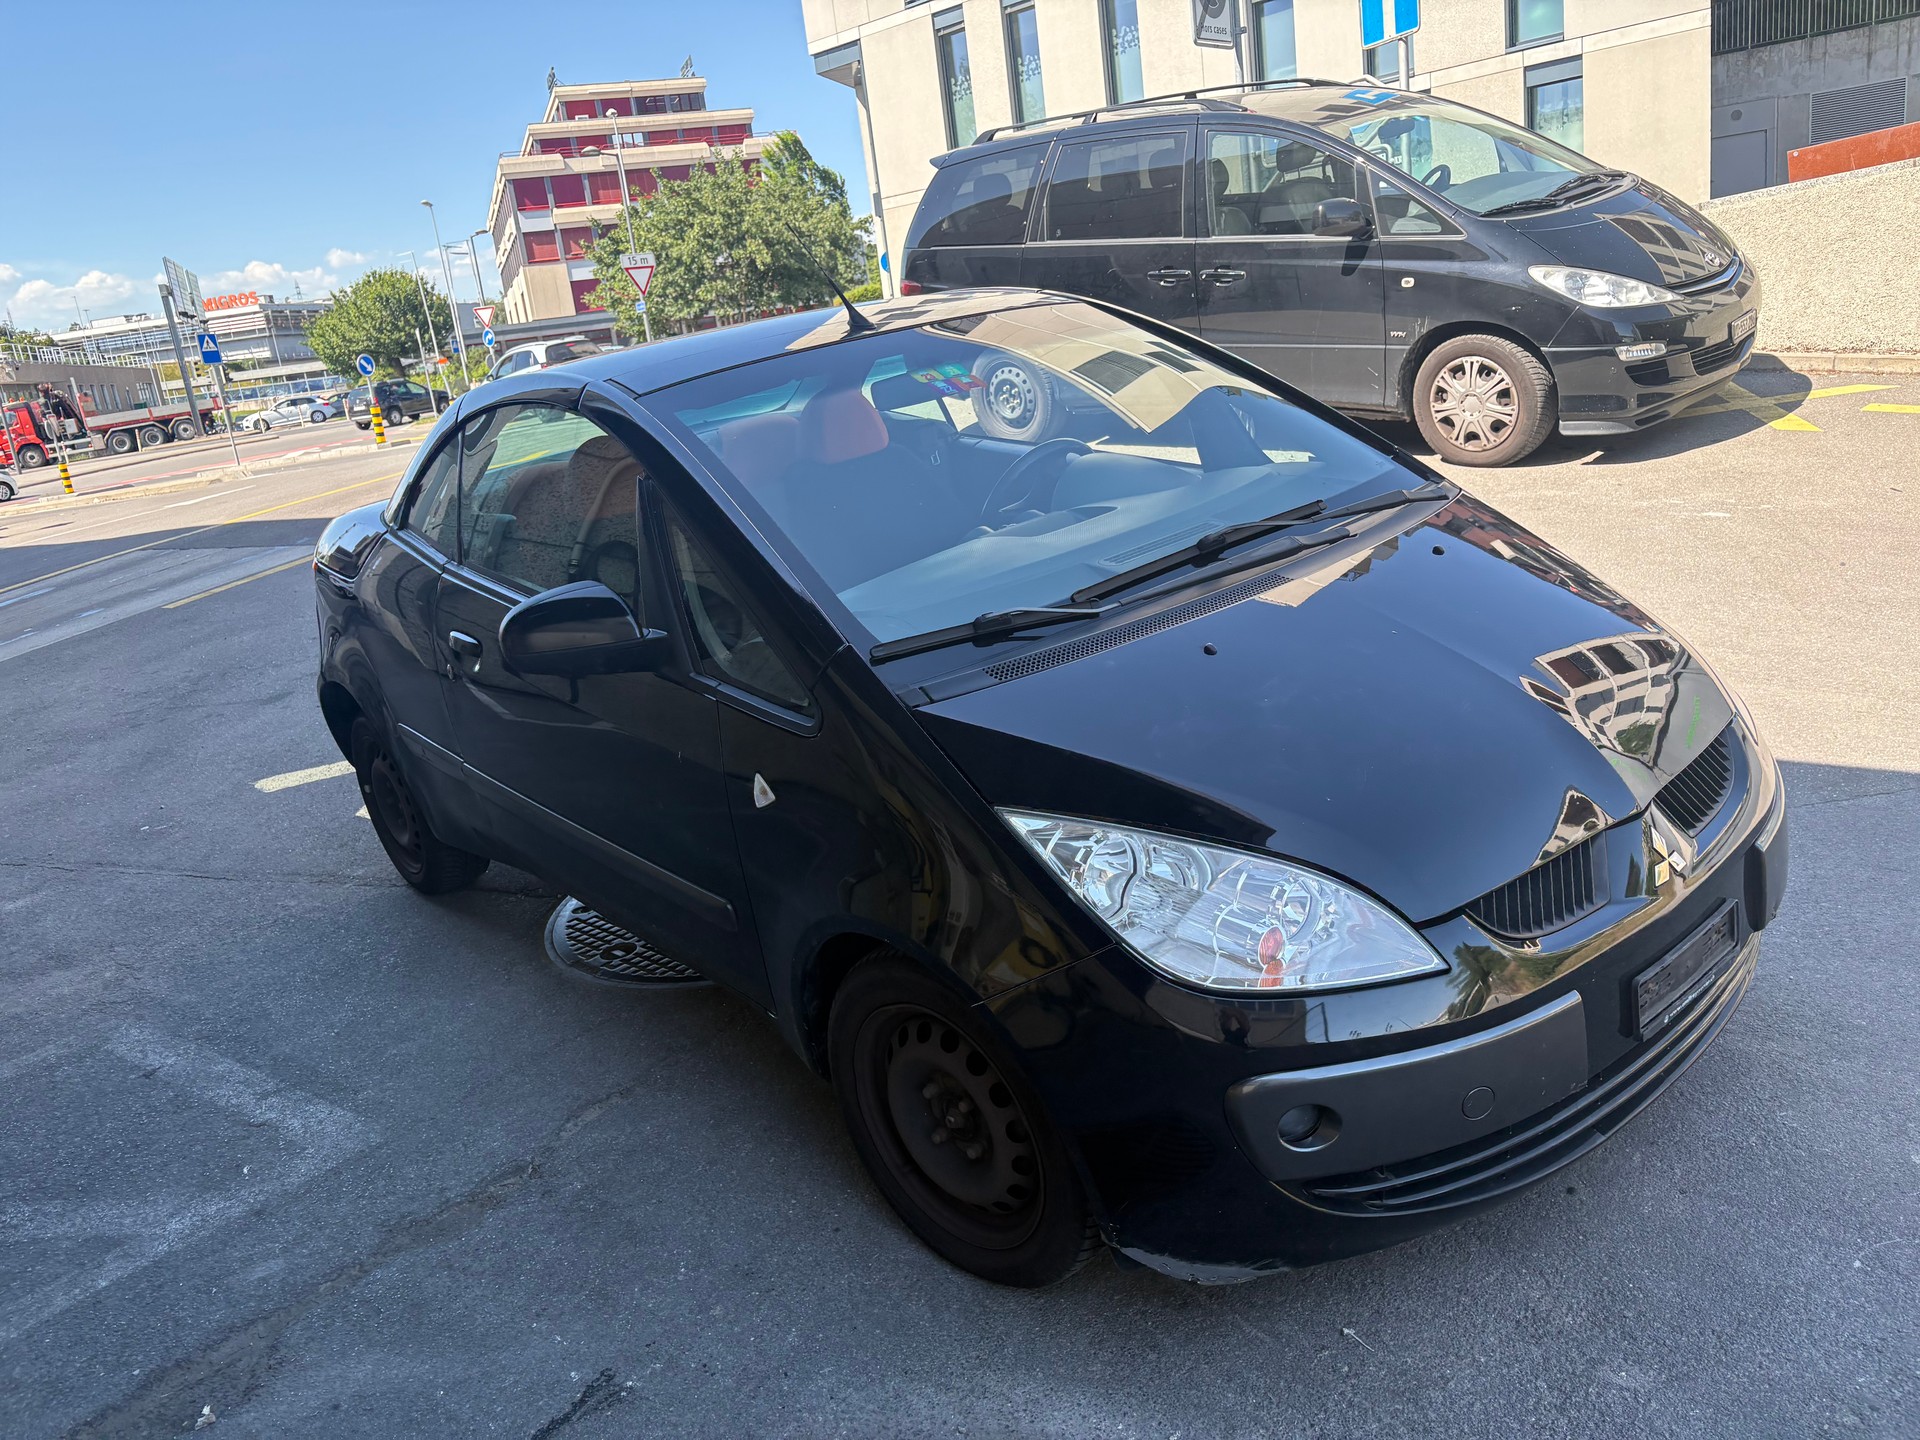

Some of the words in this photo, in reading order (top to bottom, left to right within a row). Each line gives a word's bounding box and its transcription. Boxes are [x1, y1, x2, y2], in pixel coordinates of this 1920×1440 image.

[1213, 25, 1228, 35] cases
[627, 256, 638, 266] 15
[640, 257, 649, 265] m
[202, 291, 259, 312] MIGROS
